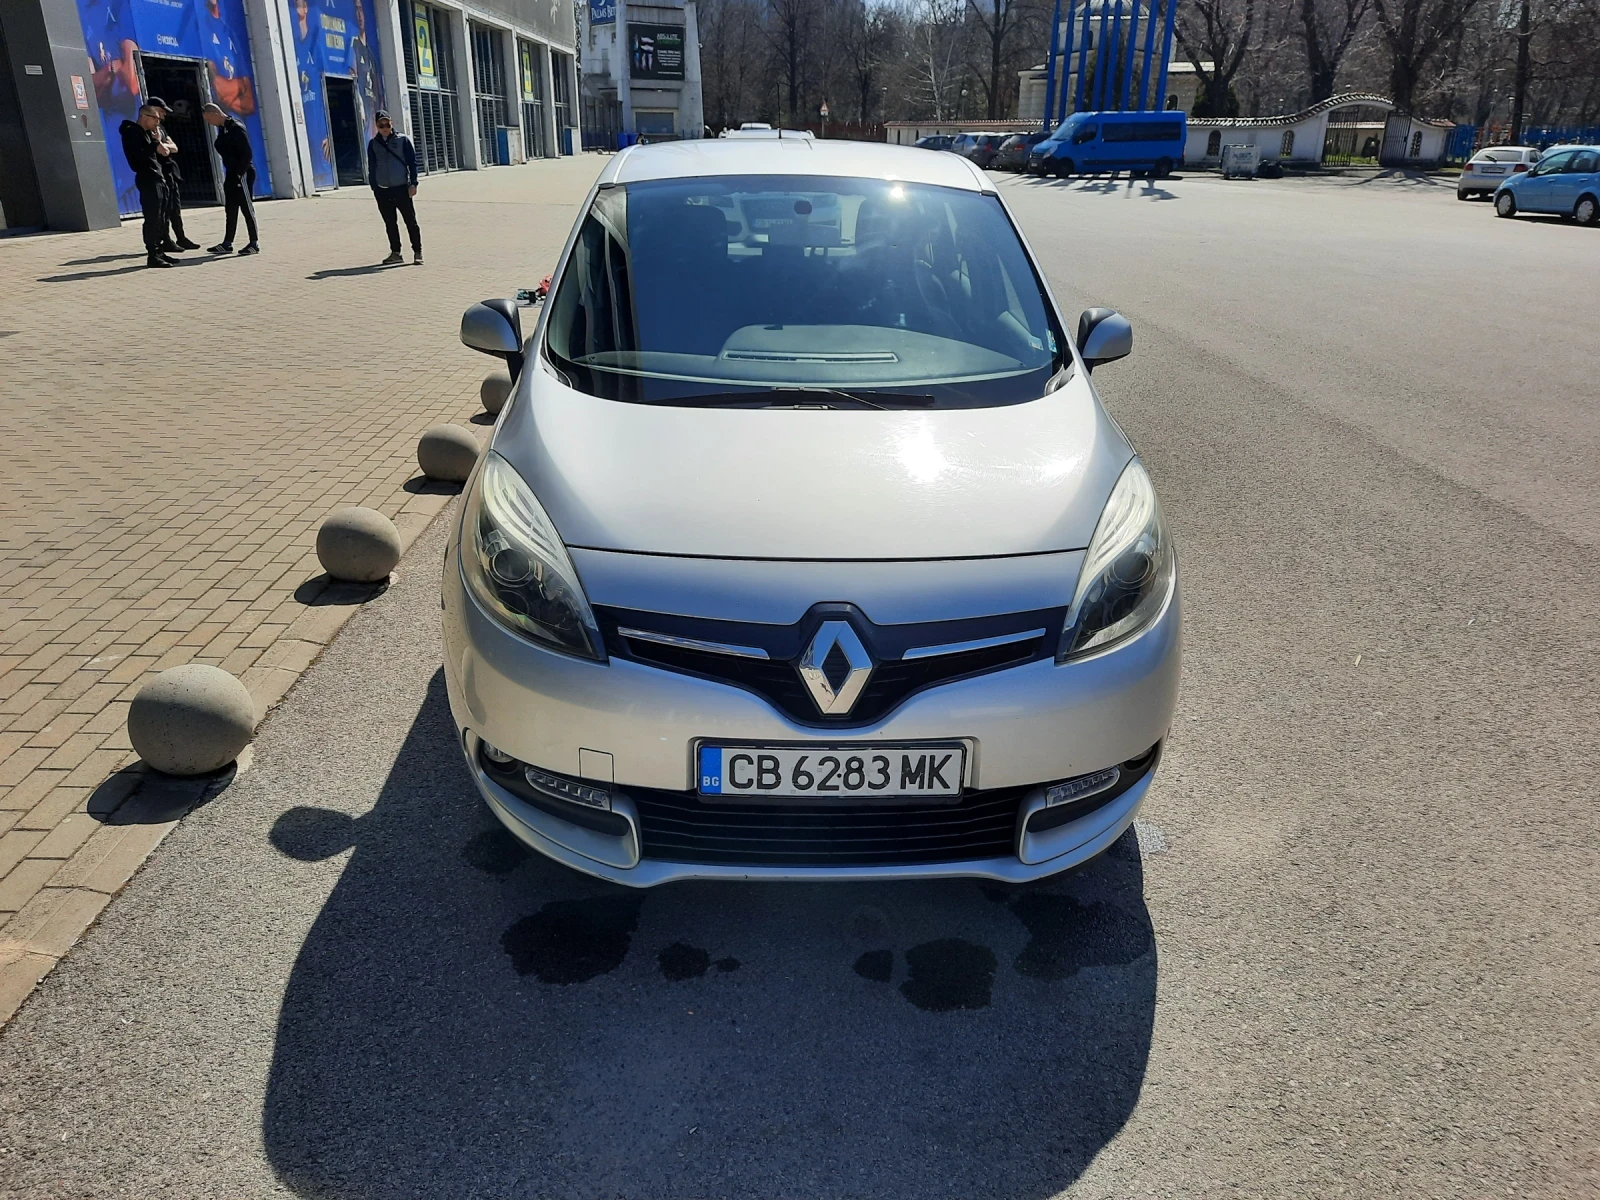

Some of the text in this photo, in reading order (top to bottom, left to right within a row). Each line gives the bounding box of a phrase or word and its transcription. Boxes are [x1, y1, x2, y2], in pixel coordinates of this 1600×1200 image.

[419, 25, 430, 68] 2
[703, 776, 719, 786] BG
[729, 754, 952, 790] CB 6283 MK
